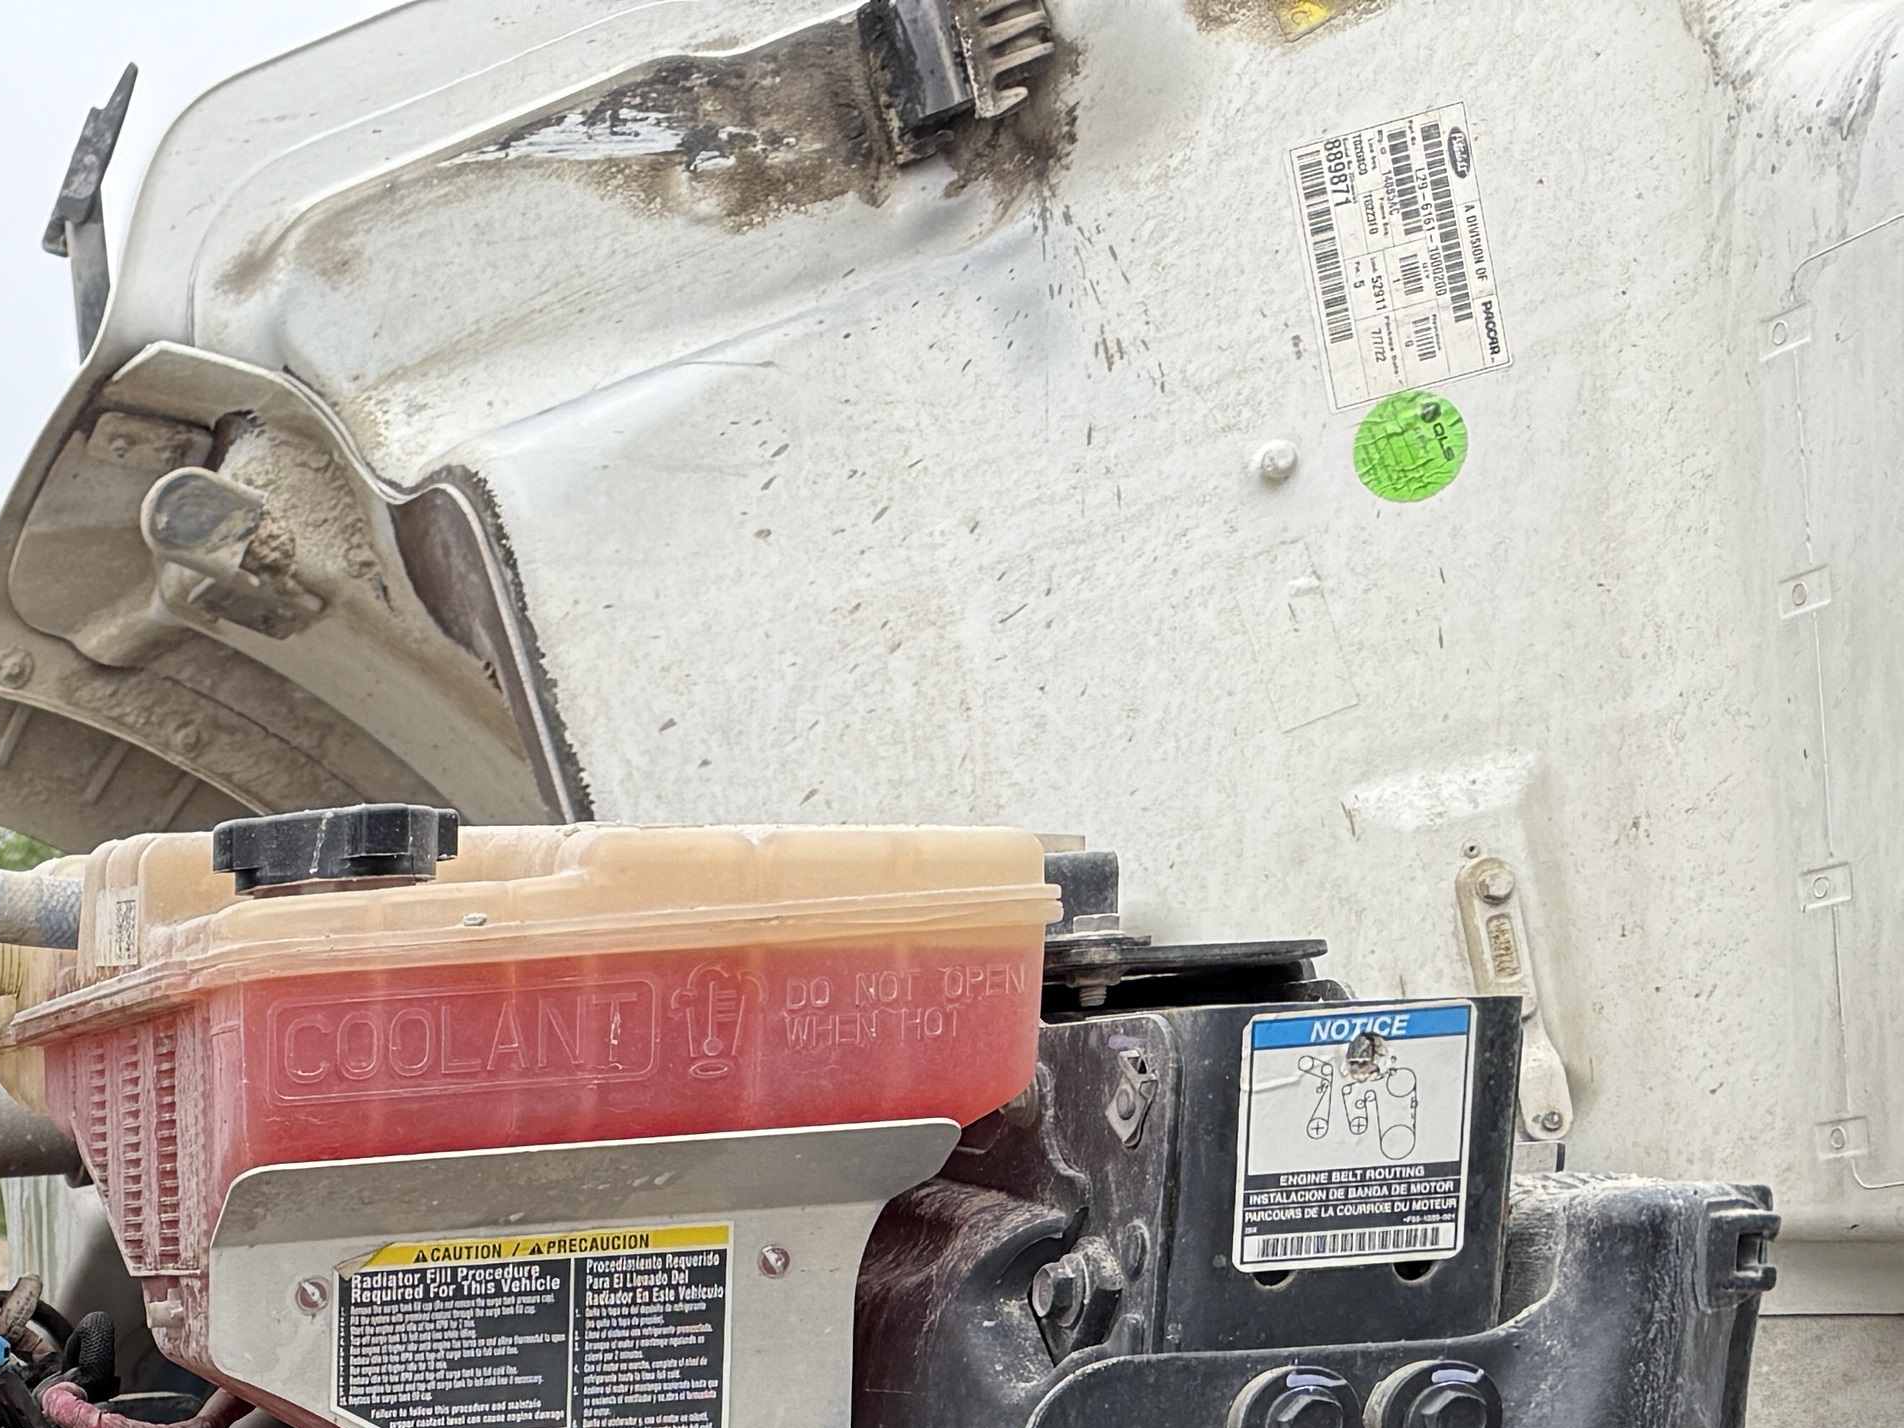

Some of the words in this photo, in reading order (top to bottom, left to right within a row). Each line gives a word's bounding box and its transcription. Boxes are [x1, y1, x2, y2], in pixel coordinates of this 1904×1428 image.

[1324, 139, 1351, 206] 889871
[1467, 217, 1485, 267] DIVISION
[1476, 267, 1488, 281] OF
[1354, 279, 1365, 289] 5
[1371, 277, 1387, 311] 52911
[1481, 300, 1501, 356] PACCAR
[1433, 422, 1455, 461] QLS
[786, 978, 832, 1011] DO
[855, 972, 917, 1008] NOT
[942, 964, 1027, 1002] OPEN
[283, 994, 642, 1084] COOLANT
[785, 1010, 878, 1055] WHEN
[899, 1006, 962, 1043] HOT
[1310, 1014, 1411, 1042] NOTICE
[1280, 1171, 1328, 1186] ENGINE
[1332, 1169, 1362, 1183] BELT
[1366, 1165, 1425, 1181] ROUTING
[1249, 1189, 1326, 1205] INSTALACION
[1329, 1188, 1345, 1200] DE
[1348, 1186, 1388, 1198] BANDA
[1392, 1184, 1407, 1196] DE
[1410, 1181, 1454, 1195] MOTOR
[1245, 1207, 1302, 1223] PARCOURS
[1304, 1207, 1318, 1218] DE
[1321, 1205, 1334, 1217] LA
[1394, 1200, 1409, 1212] DU
[1412, 1198, 1457, 1210] MOTEUR
[431, 1243, 502, 1262] CAUTION
[547, 1234, 650, 1255] PRECAUCION
[586, 1256, 662, 1273] Procedimiento
[666, 1251, 720, 1269] Requerido
[351, 1271, 420, 1288] Radiator
[426, 1268, 451, 1285] Fill
[457, 1263, 540, 1282] Procedure
[586, 1275, 610, 1290] Para
[613, 1275, 623, 1287] El
[626, 1272, 668, 1288] Llenado
[671, 1269, 689, 1284] Del
[351, 1285, 423, 1305] Required
[430, 1283, 455, 1298] For
[462, 1279, 495, 1296] This
[501, 1276, 561, 1293] Vehicle
[586, 1290, 633, 1306] Radiador
[636, 1289, 649, 1303] En
[652, 1287, 675, 1302] Este
